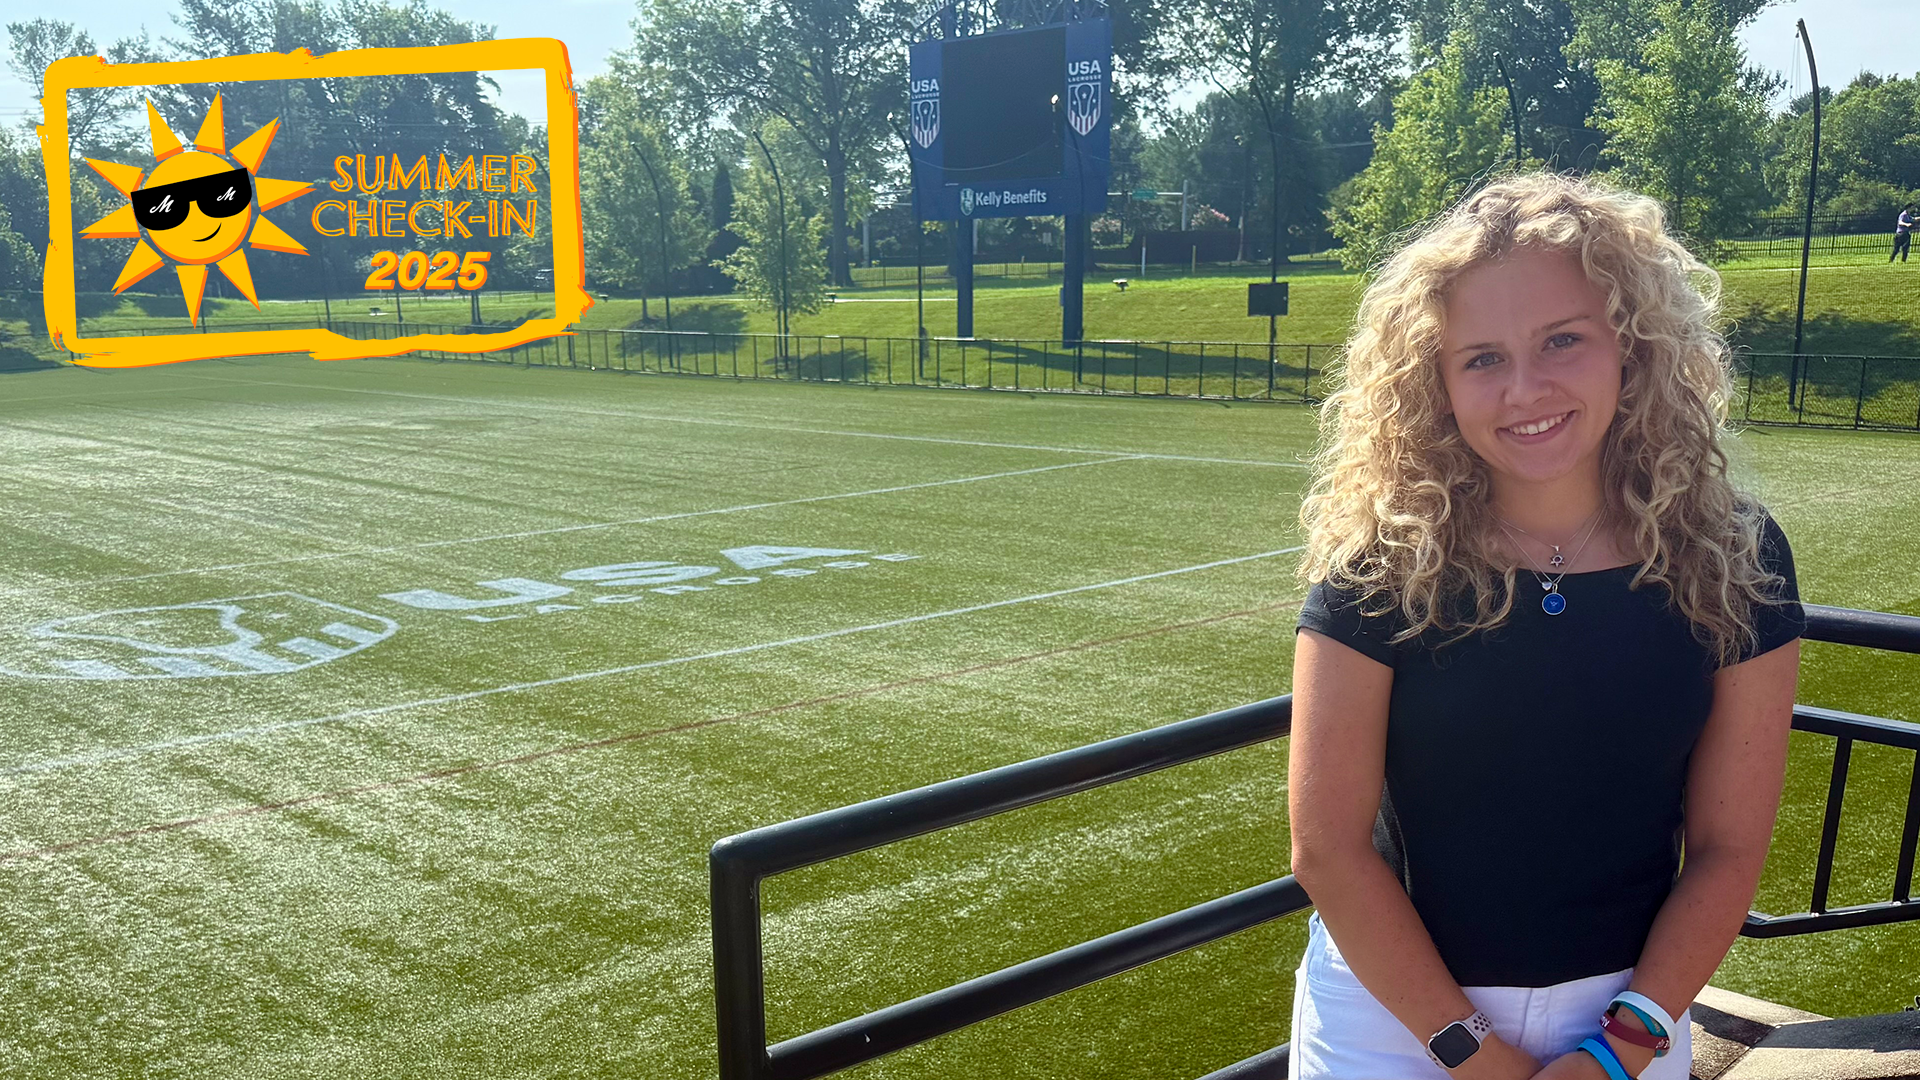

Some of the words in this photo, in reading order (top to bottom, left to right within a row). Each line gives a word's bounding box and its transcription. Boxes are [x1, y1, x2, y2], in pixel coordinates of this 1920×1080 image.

[1068, 59, 1102, 76] USA
[911, 78, 940, 94] USA
[975, 191, 1002, 208] Kelly
[1003, 188, 1047, 204] Benefits
[377, 545, 873, 611] USA
